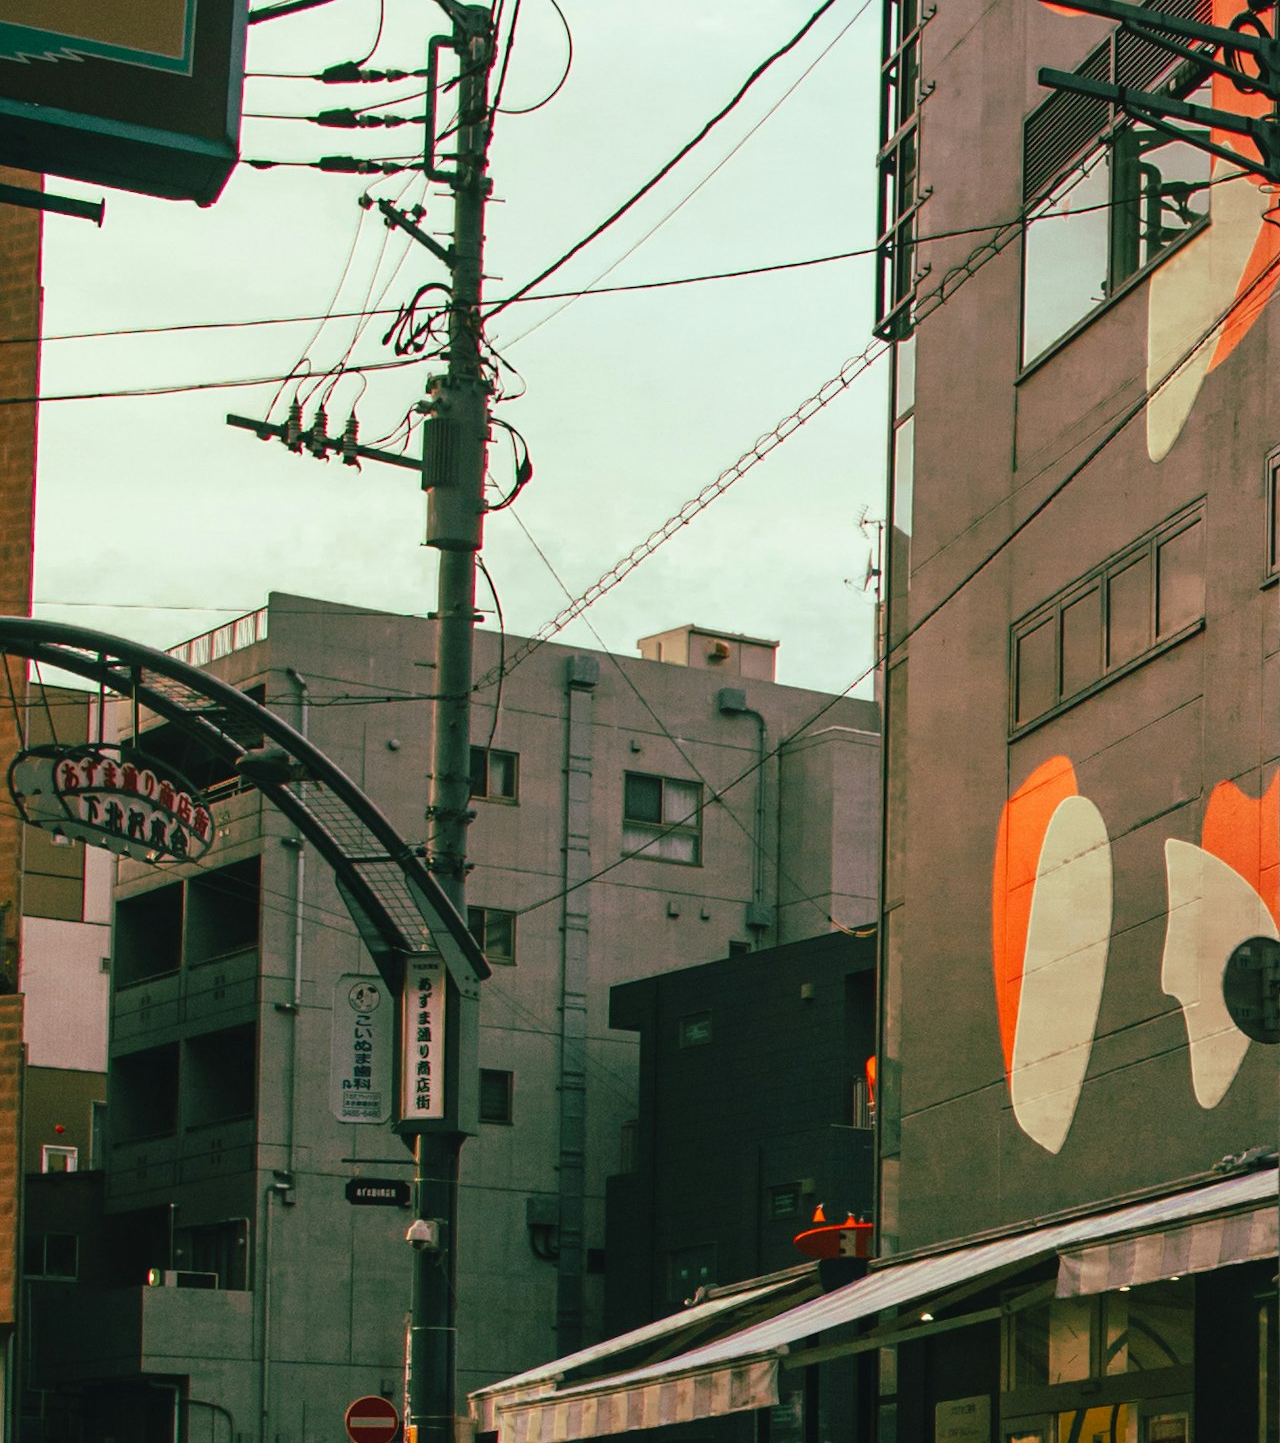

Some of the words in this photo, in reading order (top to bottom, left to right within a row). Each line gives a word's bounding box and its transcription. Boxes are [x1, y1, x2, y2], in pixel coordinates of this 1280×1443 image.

[62, 761, 210, 842] あずま通り商店街
[82, 795, 188, 856] 下北沢東会
[354, 1014, 373, 1091] こいぬま歯科
[416, 977, 433, 1110] あずま通り商店街
